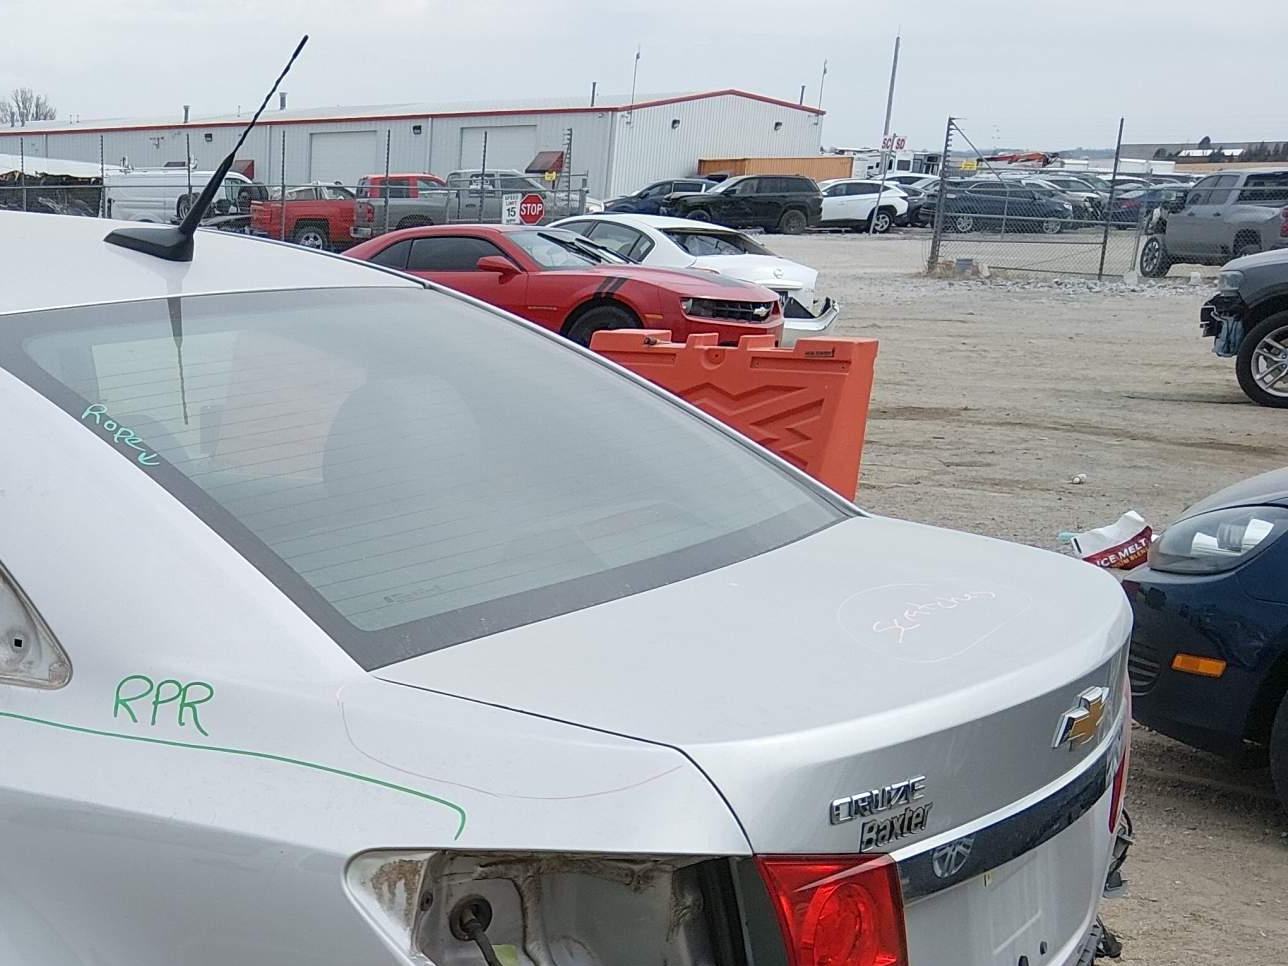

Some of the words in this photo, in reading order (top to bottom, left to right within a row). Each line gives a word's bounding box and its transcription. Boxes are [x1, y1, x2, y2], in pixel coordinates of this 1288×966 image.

[506, 206, 517, 217] 15
[520, 203, 543, 216] STOP
[1118, 538, 1147, 560] MELT
[113, 674, 214, 737] RPR
[829, 776, 926, 825] CRUZE
[859, 801, 934, 853] Baxter
